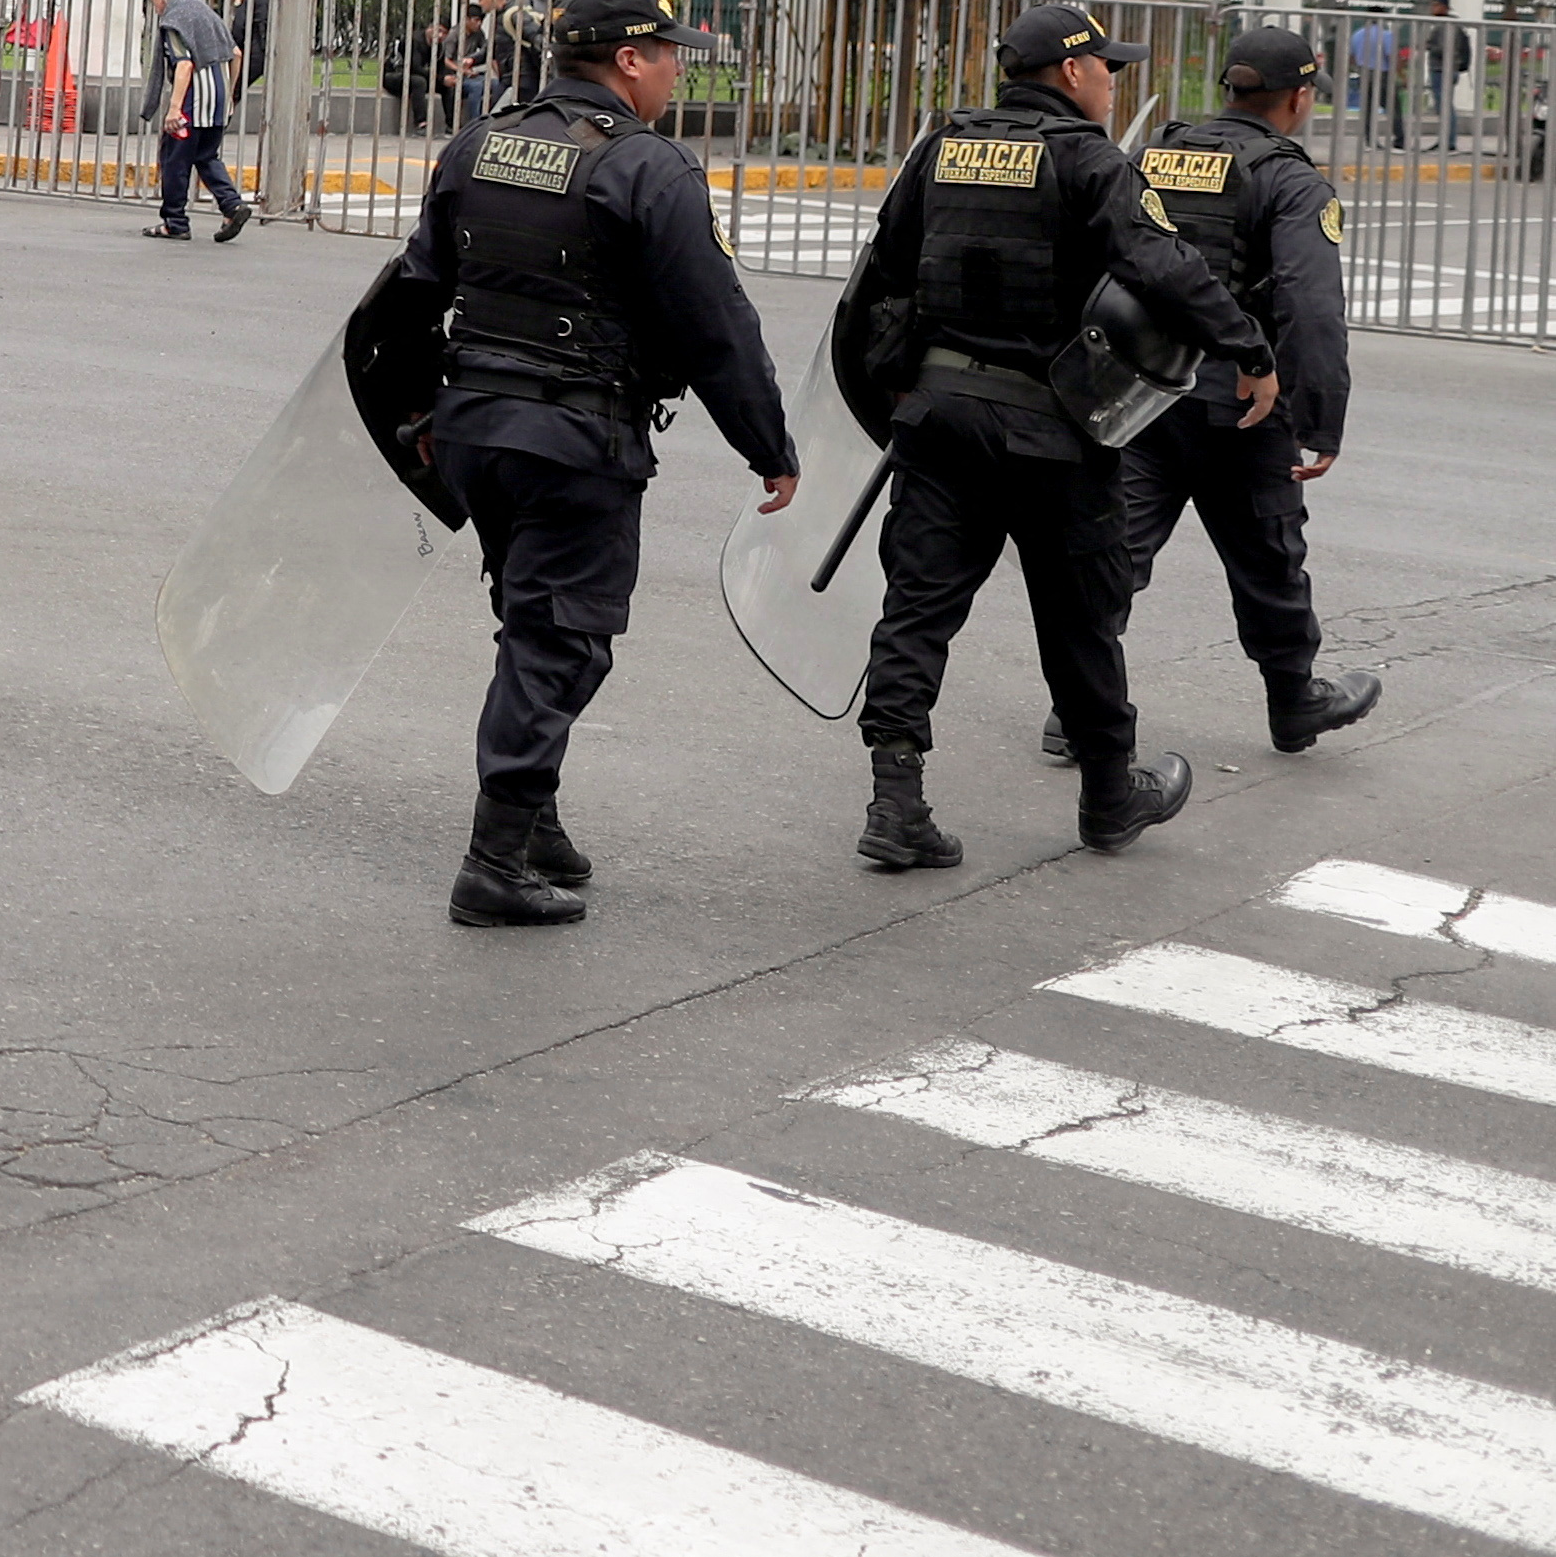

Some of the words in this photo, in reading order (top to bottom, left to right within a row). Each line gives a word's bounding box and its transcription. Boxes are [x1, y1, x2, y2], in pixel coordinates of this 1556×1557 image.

[1062, 30, 1091, 49] PERU
[483, 136, 569, 174] POLICIA
[940, 142, 1034, 171] POLICIA
[1144, 152, 1222, 178] POLICIA
[478, 161, 516, 180] FUERZAS
[515, 167, 565, 189] ESPECIALES
[938, 167, 977, 180] FUERZAS
[978, 169, 1032, 183] ESPECIALES
